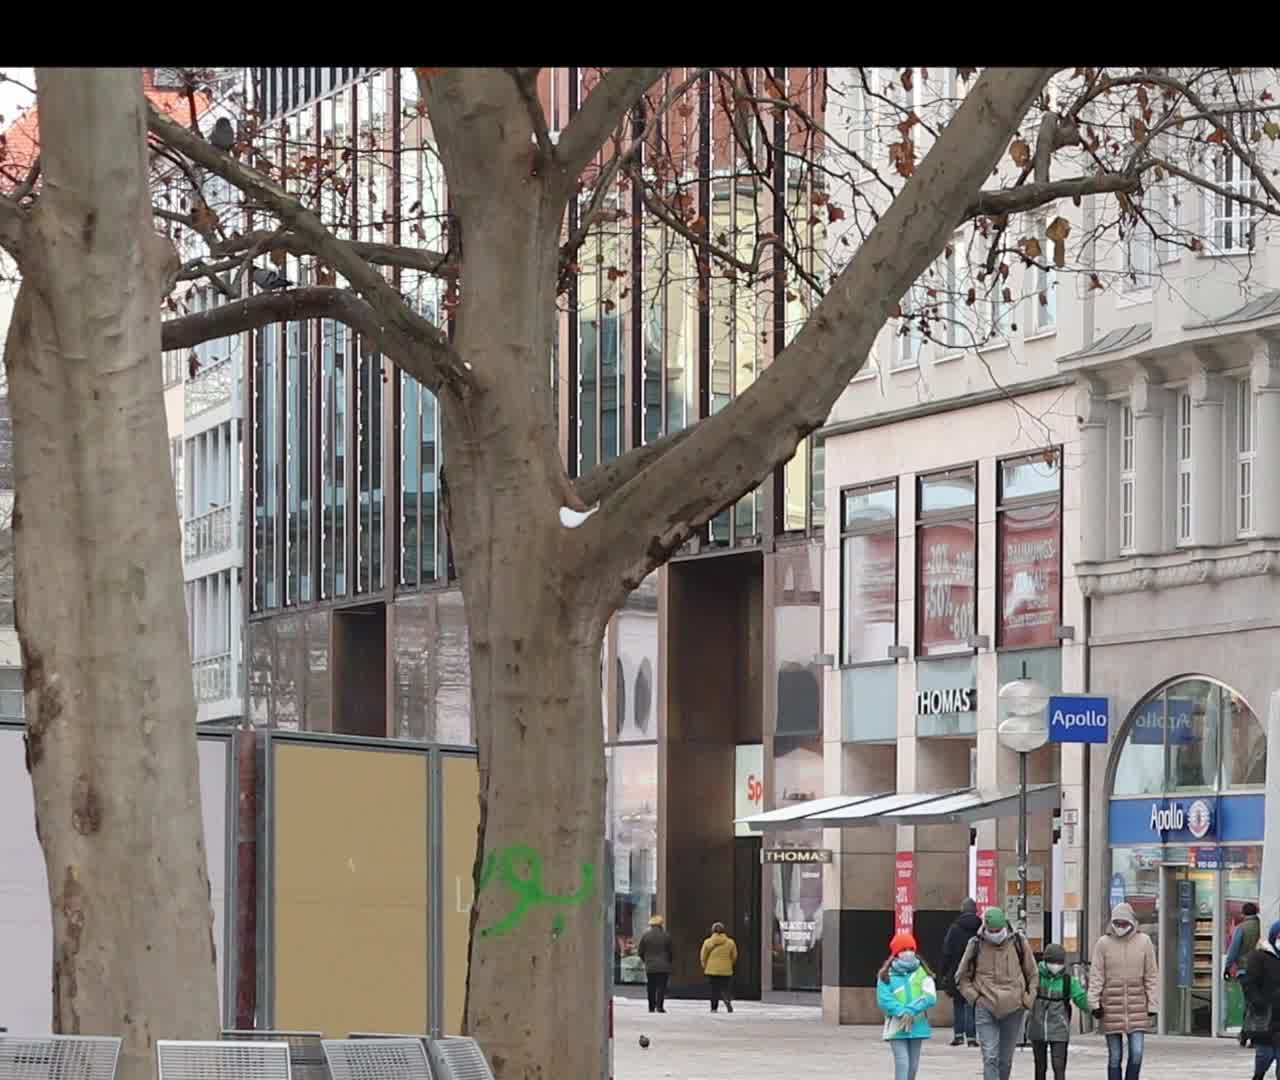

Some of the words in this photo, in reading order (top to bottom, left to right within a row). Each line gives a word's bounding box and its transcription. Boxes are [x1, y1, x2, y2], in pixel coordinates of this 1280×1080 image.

[915, 688, 972, 715] THOMAS
[1052, 709, 1107, 729] Apollo
[747, 775, 763, 804] Sp
[1150, 803, 1184, 837] Apollo
[767, 851, 825, 862] THOMAS
